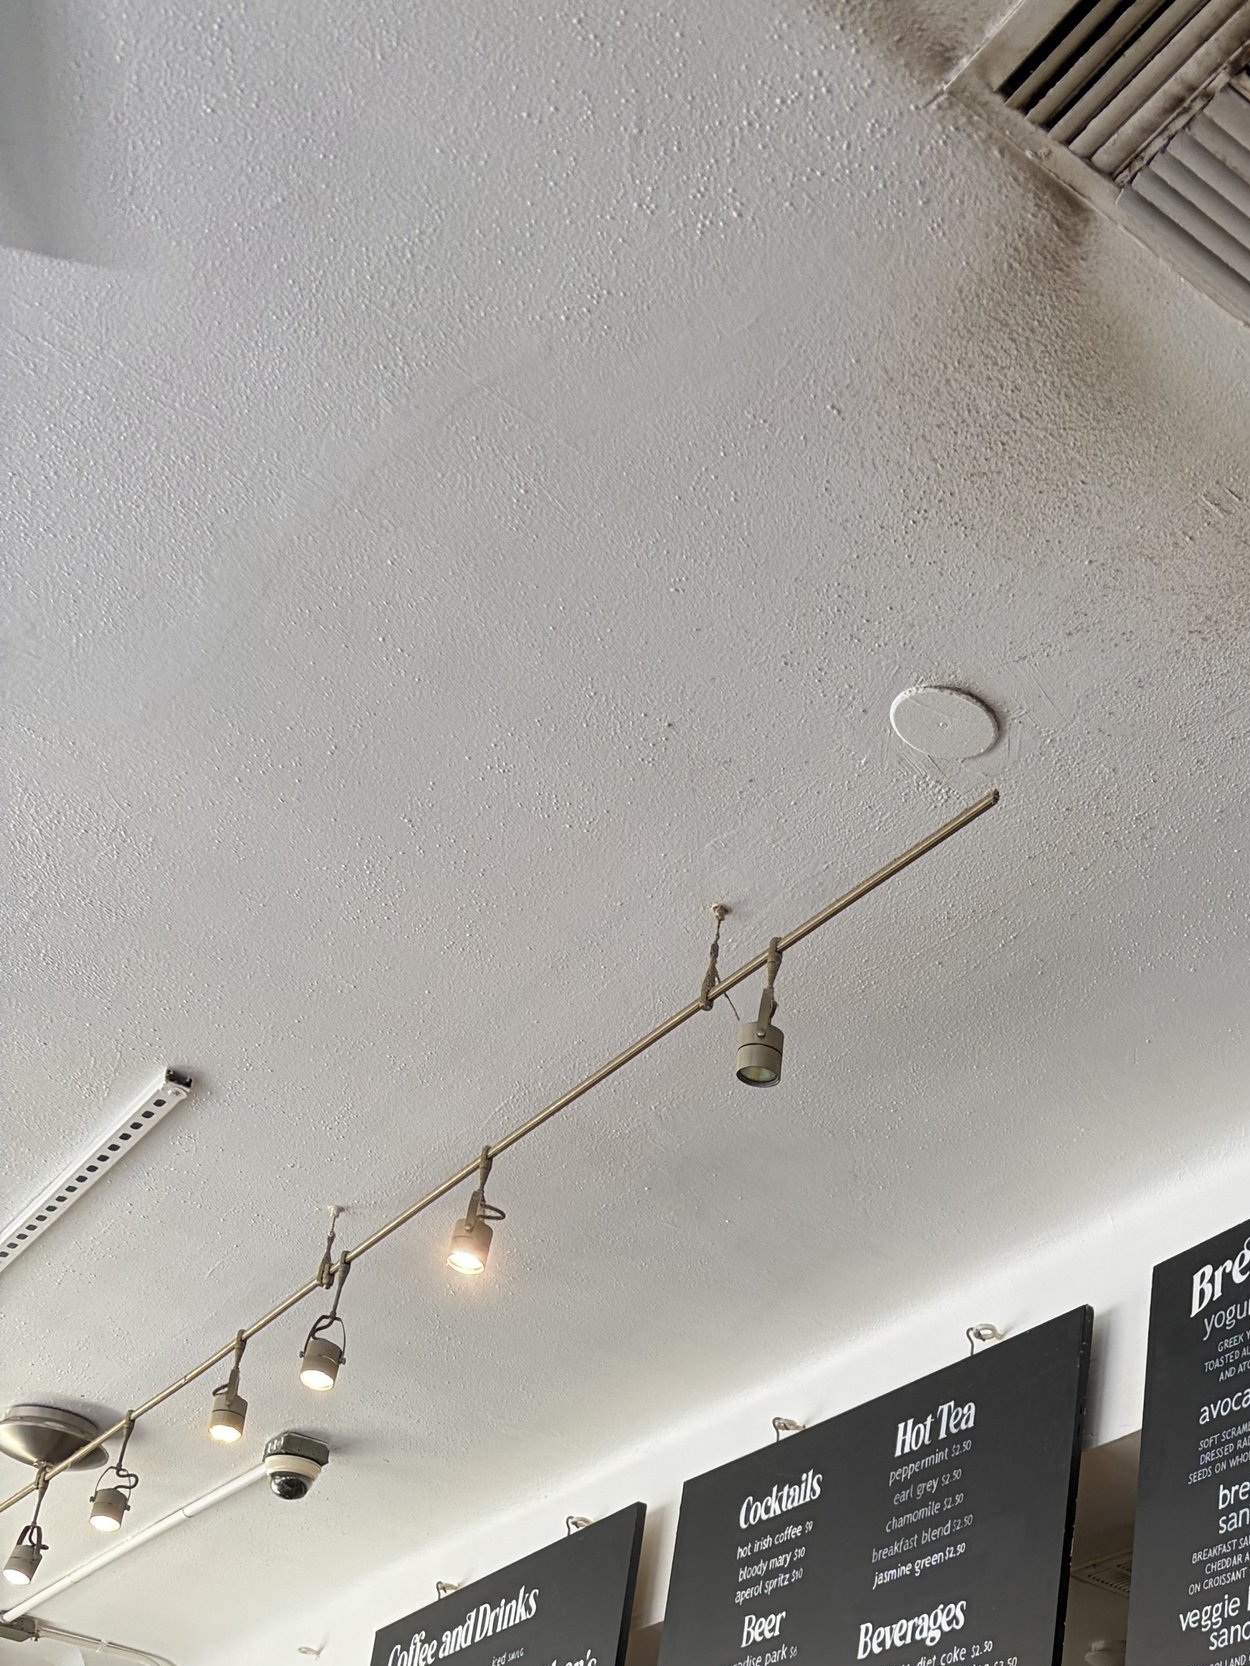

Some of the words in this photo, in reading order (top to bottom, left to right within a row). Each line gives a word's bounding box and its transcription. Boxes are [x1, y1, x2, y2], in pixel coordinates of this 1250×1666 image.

[894, 1418, 933, 1458] Hot
[938, 1400, 976, 1434] Tea
[739, 1469, 823, 1529] Cocktails
[439, 1608, 477, 1659] and
[474, 1585, 539, 1641] Drinks
[741, 1609, 786, 1648] Beer
[857, 1600, 966, 1660] Beverages
[1179, 1593, 1240, 1632] veggie
